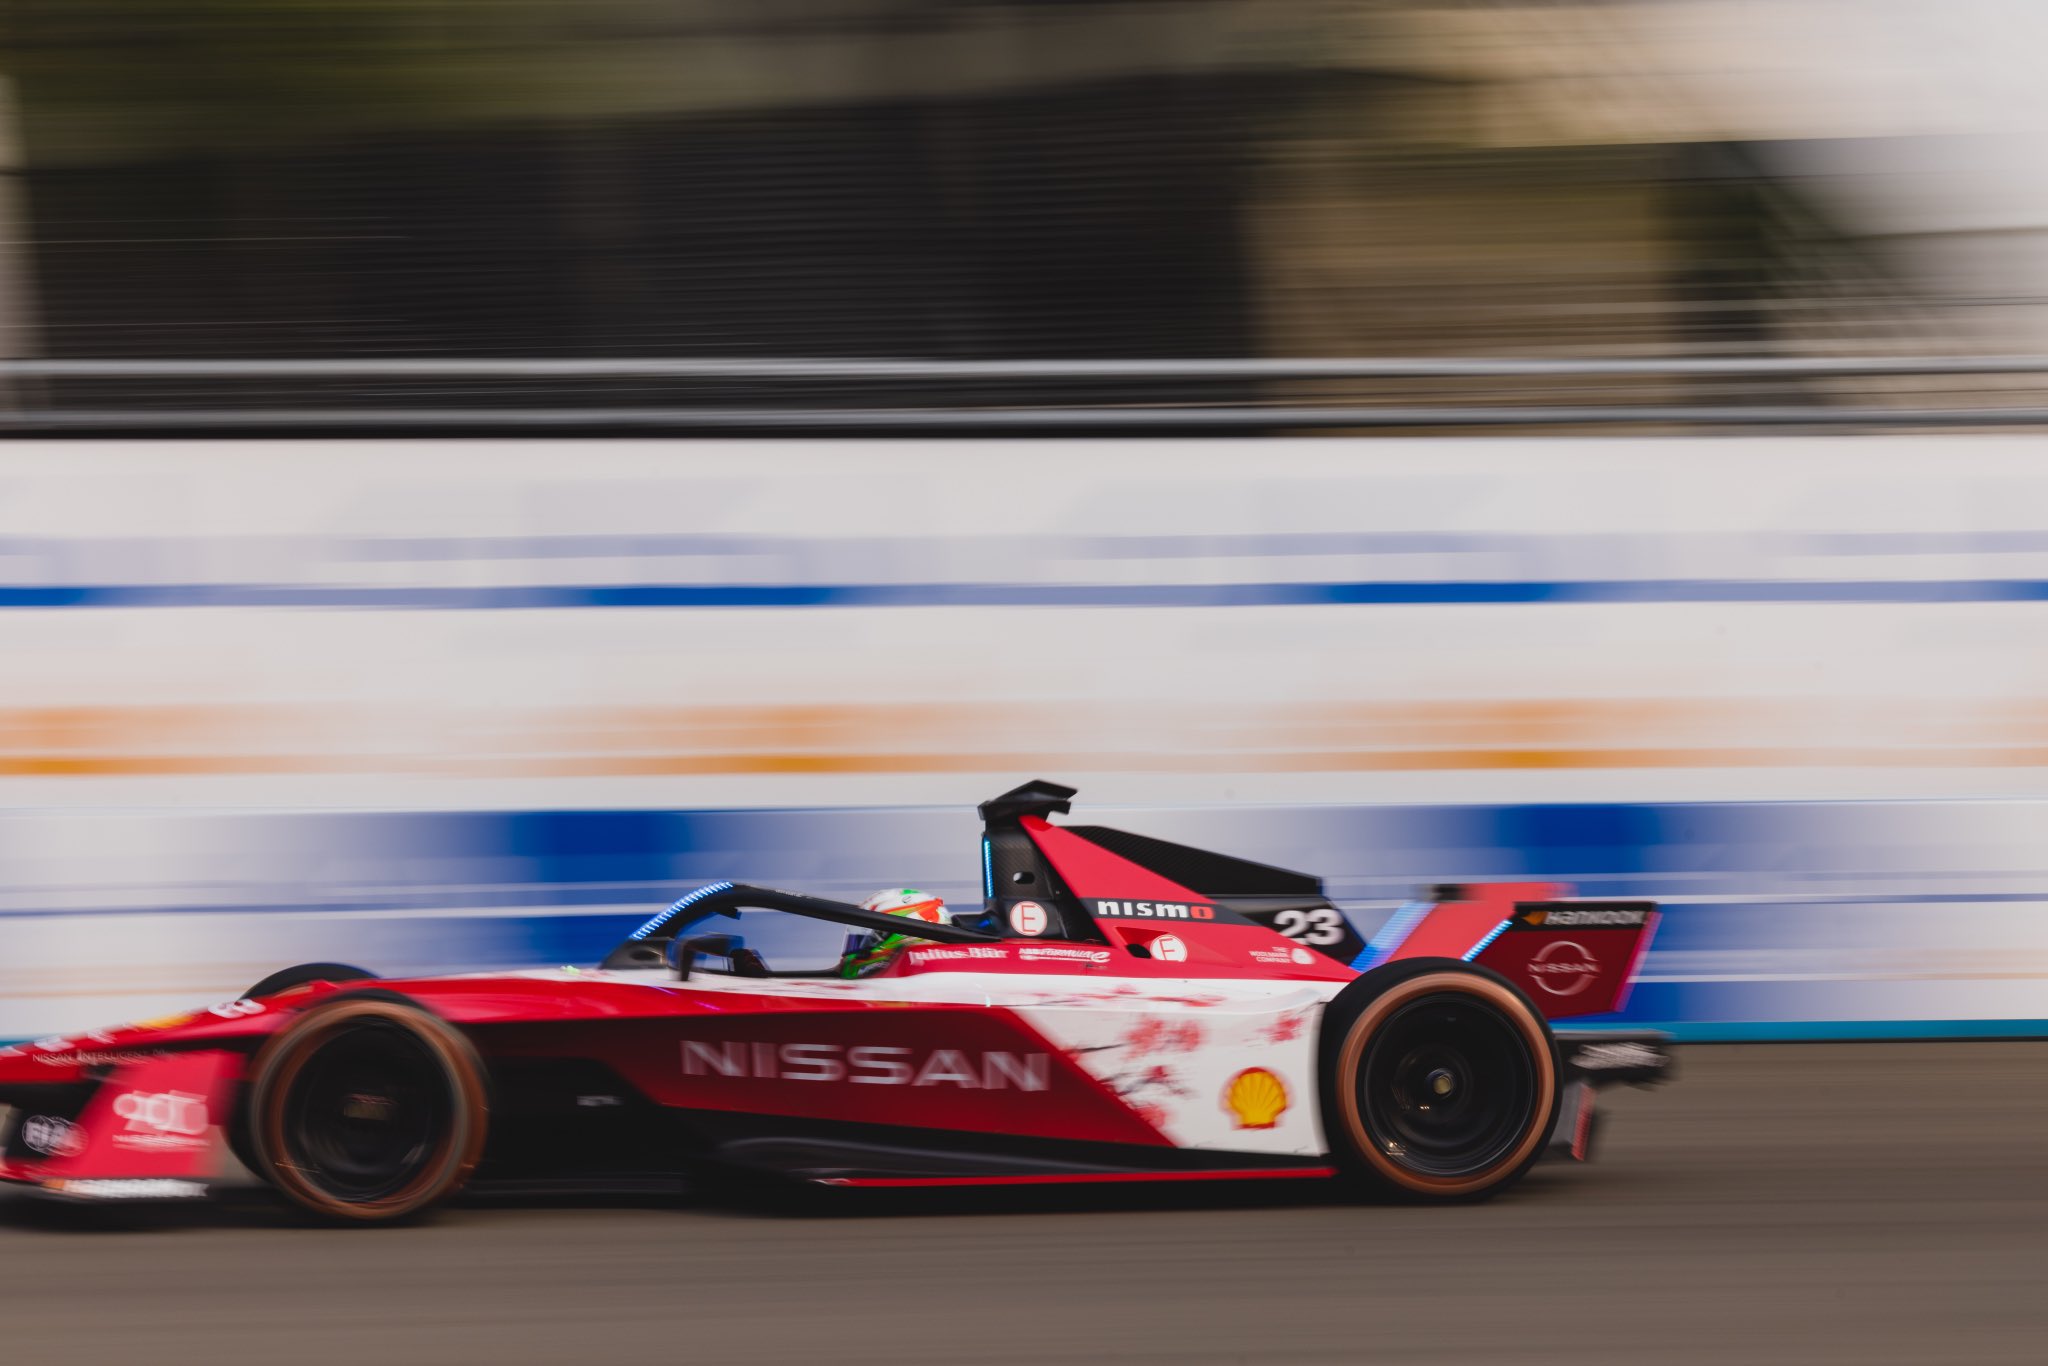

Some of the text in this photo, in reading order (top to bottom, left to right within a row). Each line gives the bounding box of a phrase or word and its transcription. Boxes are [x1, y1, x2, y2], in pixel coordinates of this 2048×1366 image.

[1273, 908, 1345, 946] 23
[1528, 962, 1601, 975] NISSAN
[32, 1053, 73, 1065] NISSAN
[680, 1040, 1050, 1092] NISSAN
